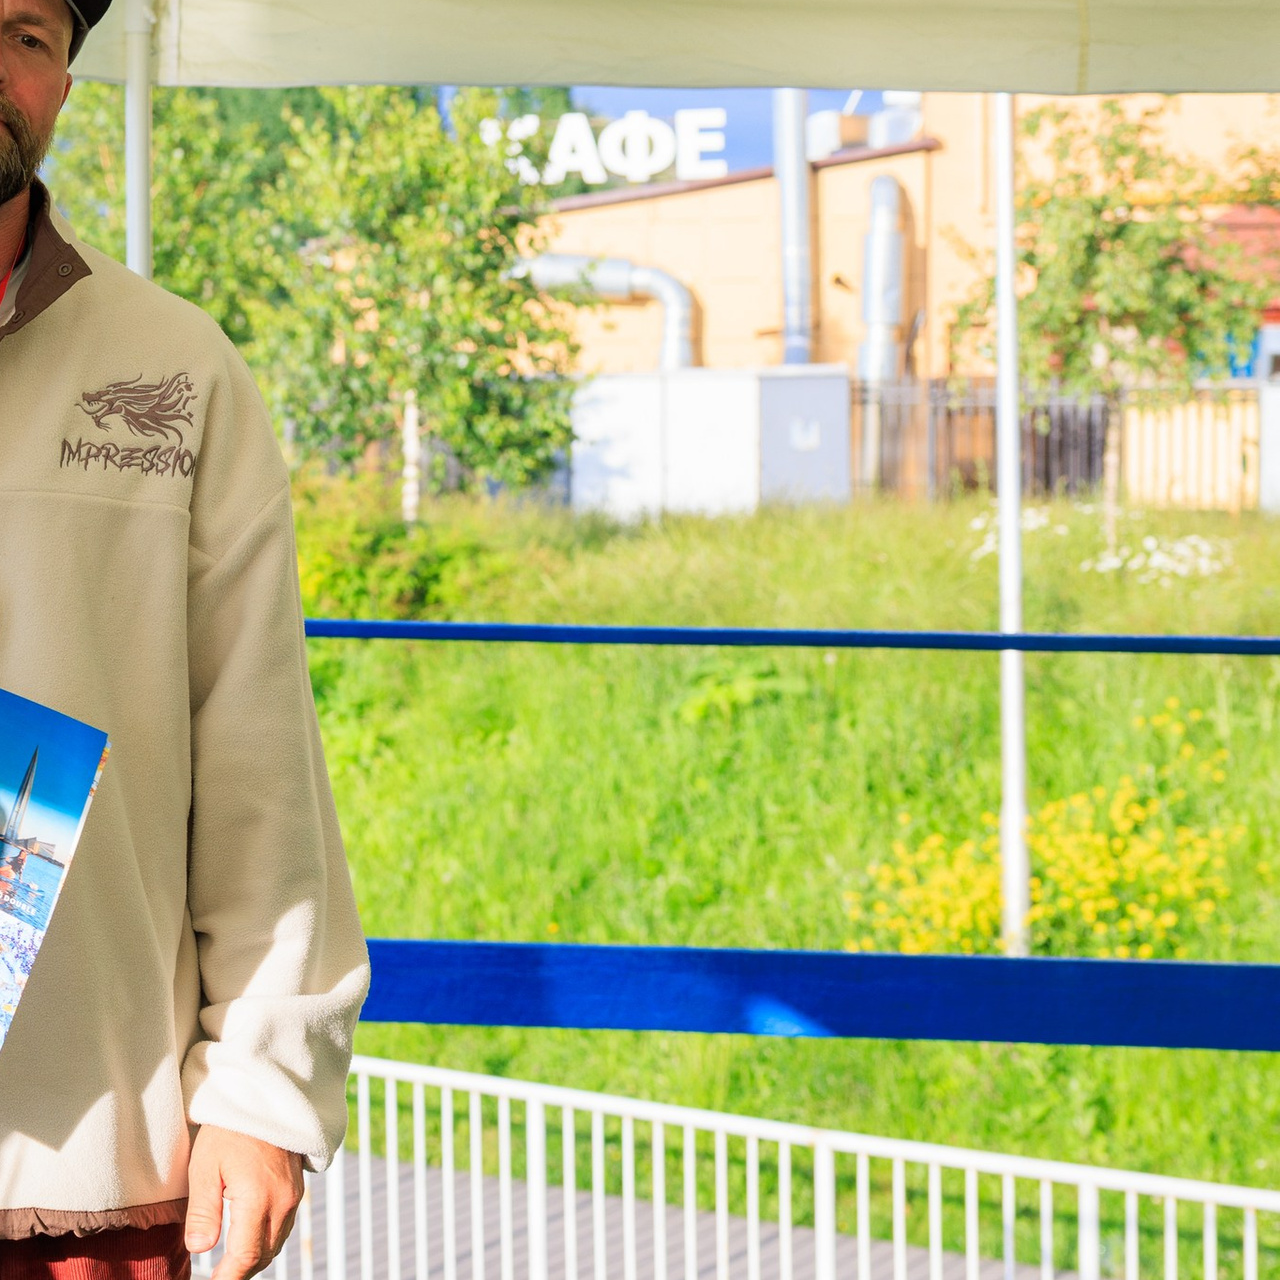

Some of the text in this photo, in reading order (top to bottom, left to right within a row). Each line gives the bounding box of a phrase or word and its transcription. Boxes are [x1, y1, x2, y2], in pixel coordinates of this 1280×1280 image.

[479, 108, 729, 185] КАФЕ
[60, 437, 197, 478] MPRESSIO
[3, 894, 37, 916] DOUBLE
